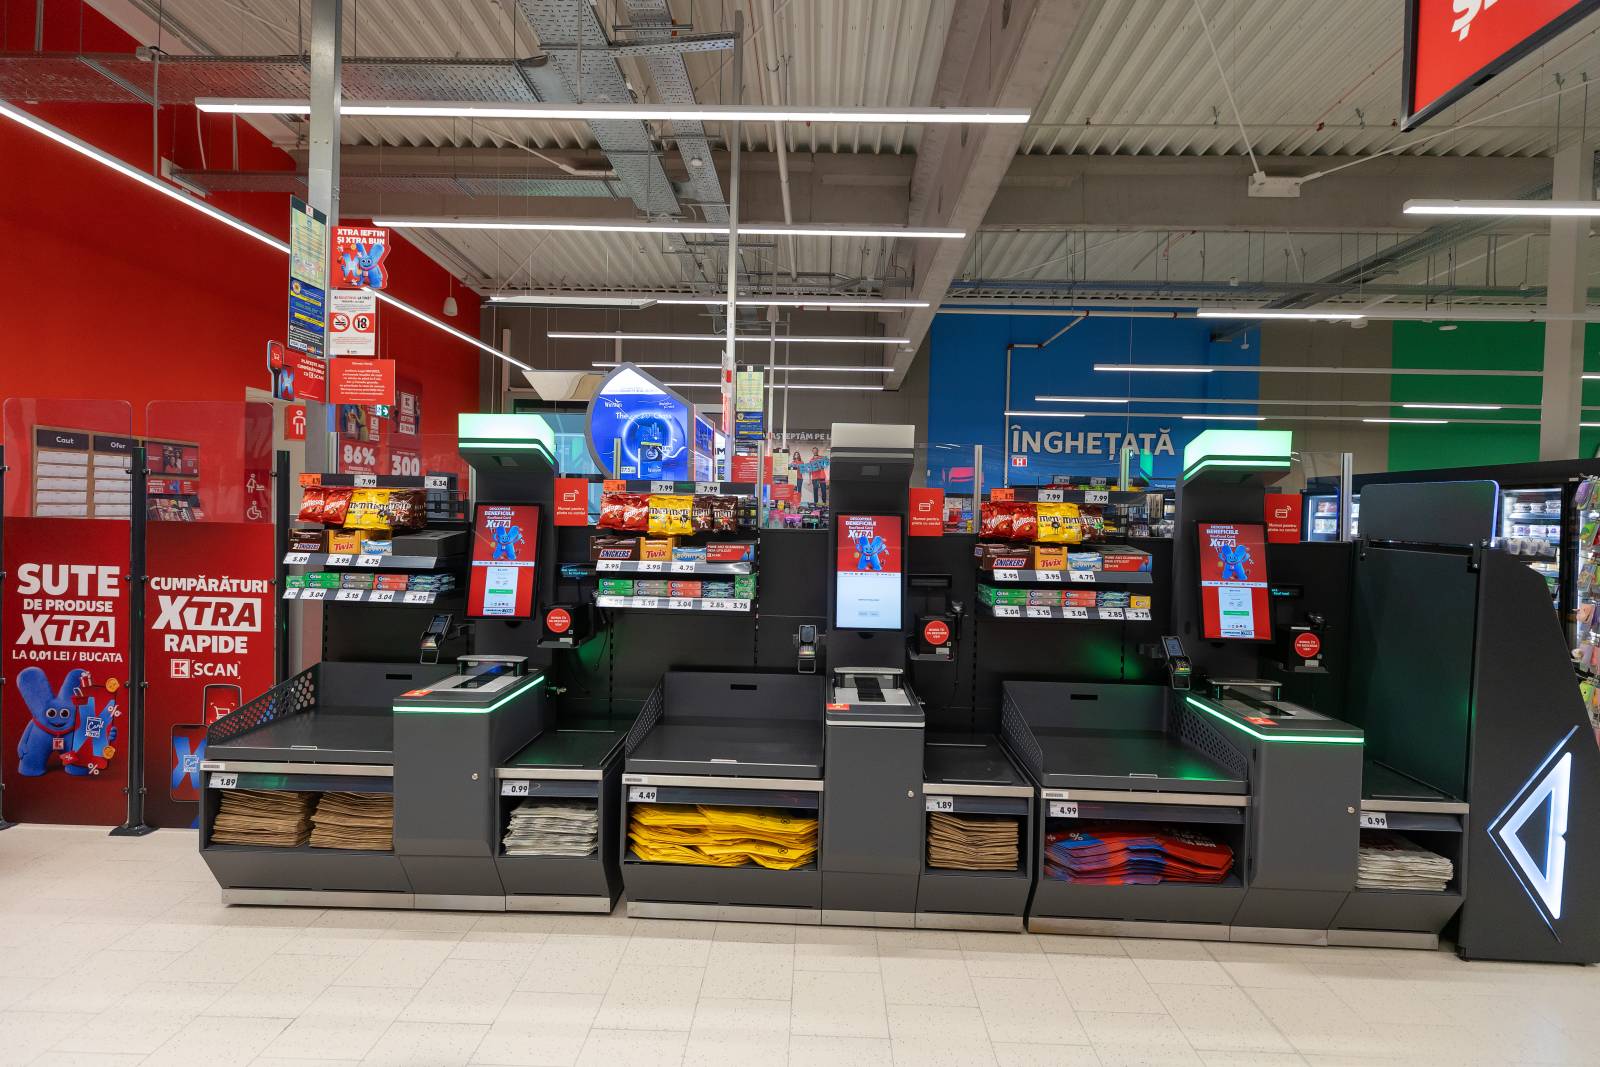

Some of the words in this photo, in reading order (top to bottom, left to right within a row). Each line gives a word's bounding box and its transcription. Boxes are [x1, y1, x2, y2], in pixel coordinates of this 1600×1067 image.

[360, 229, 385, 237] IEFTIN
[357, 317, 367, 329] 18
[56, 436, 74, 444] Caut
[1011, 424, 1175, 460] ÎNGHEȚATĂ
[344, 444, 376, 466] 86%
[391, 454, 420, 476] 300
[485, 520, 511, 528] XTRA
[848, 530, 873, 538] XTRA
[600, 549, 632, 559] SNICKERS
[645, 549, 666, 558] Twix
[993, 558, 1026, 568] SNICKERS
[1040, 559, 1062, 568] Twix
[17, 563, 121, 597] SUTE
[150, 575, 268, 593] CUMPĂRĂTURI
[23, 599, 44, 611] DE
[45, 600, 113, 612] PRODUSE
[152, 595, 262, 632] XTRA
[16, 614, 116, 647] XTRA
[164, 634, 248, 654] RAPIDE
[12, 650, 27, 660] LA
[29, 650, 51, 662] 0,01
[53, 652, 70, 661] LEI
[79, 653, 123, 663] BUCATA
[193, 663, 238, 677] SCAN
[220, 778, 236, 787] 1.89
[511, 785, 528, 793] 0.99
[638, 791, 656, 800] 4.49
[936, 801, 952, 810] 1.89
[1060, 806, 1077, 815] 4.99
[1367, 817, 1385, 826] 0.99
